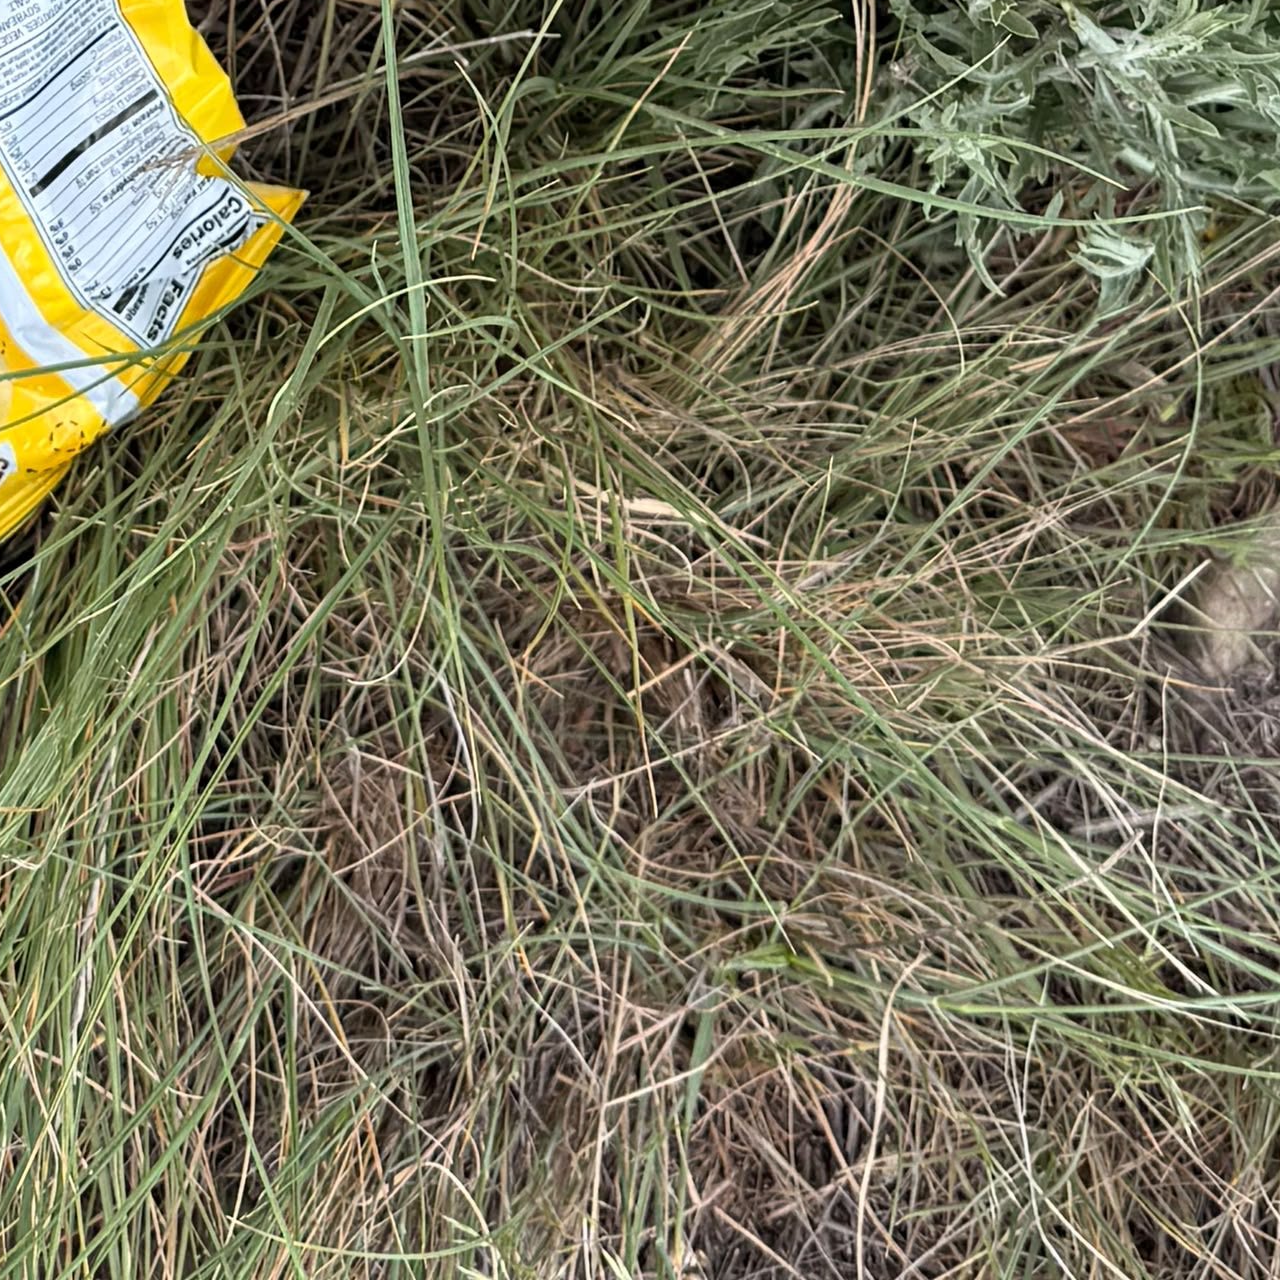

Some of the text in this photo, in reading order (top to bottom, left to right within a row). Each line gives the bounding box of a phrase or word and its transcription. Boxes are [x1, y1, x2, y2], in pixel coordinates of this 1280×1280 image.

[21, 0, 65, 33] POTATOES,
[130, 99, 165, 128] Protein
[171, 196, 243, 258] Calories
[66, 256, 83, 272] 0%
[144, 279, 184, 341] Facts
